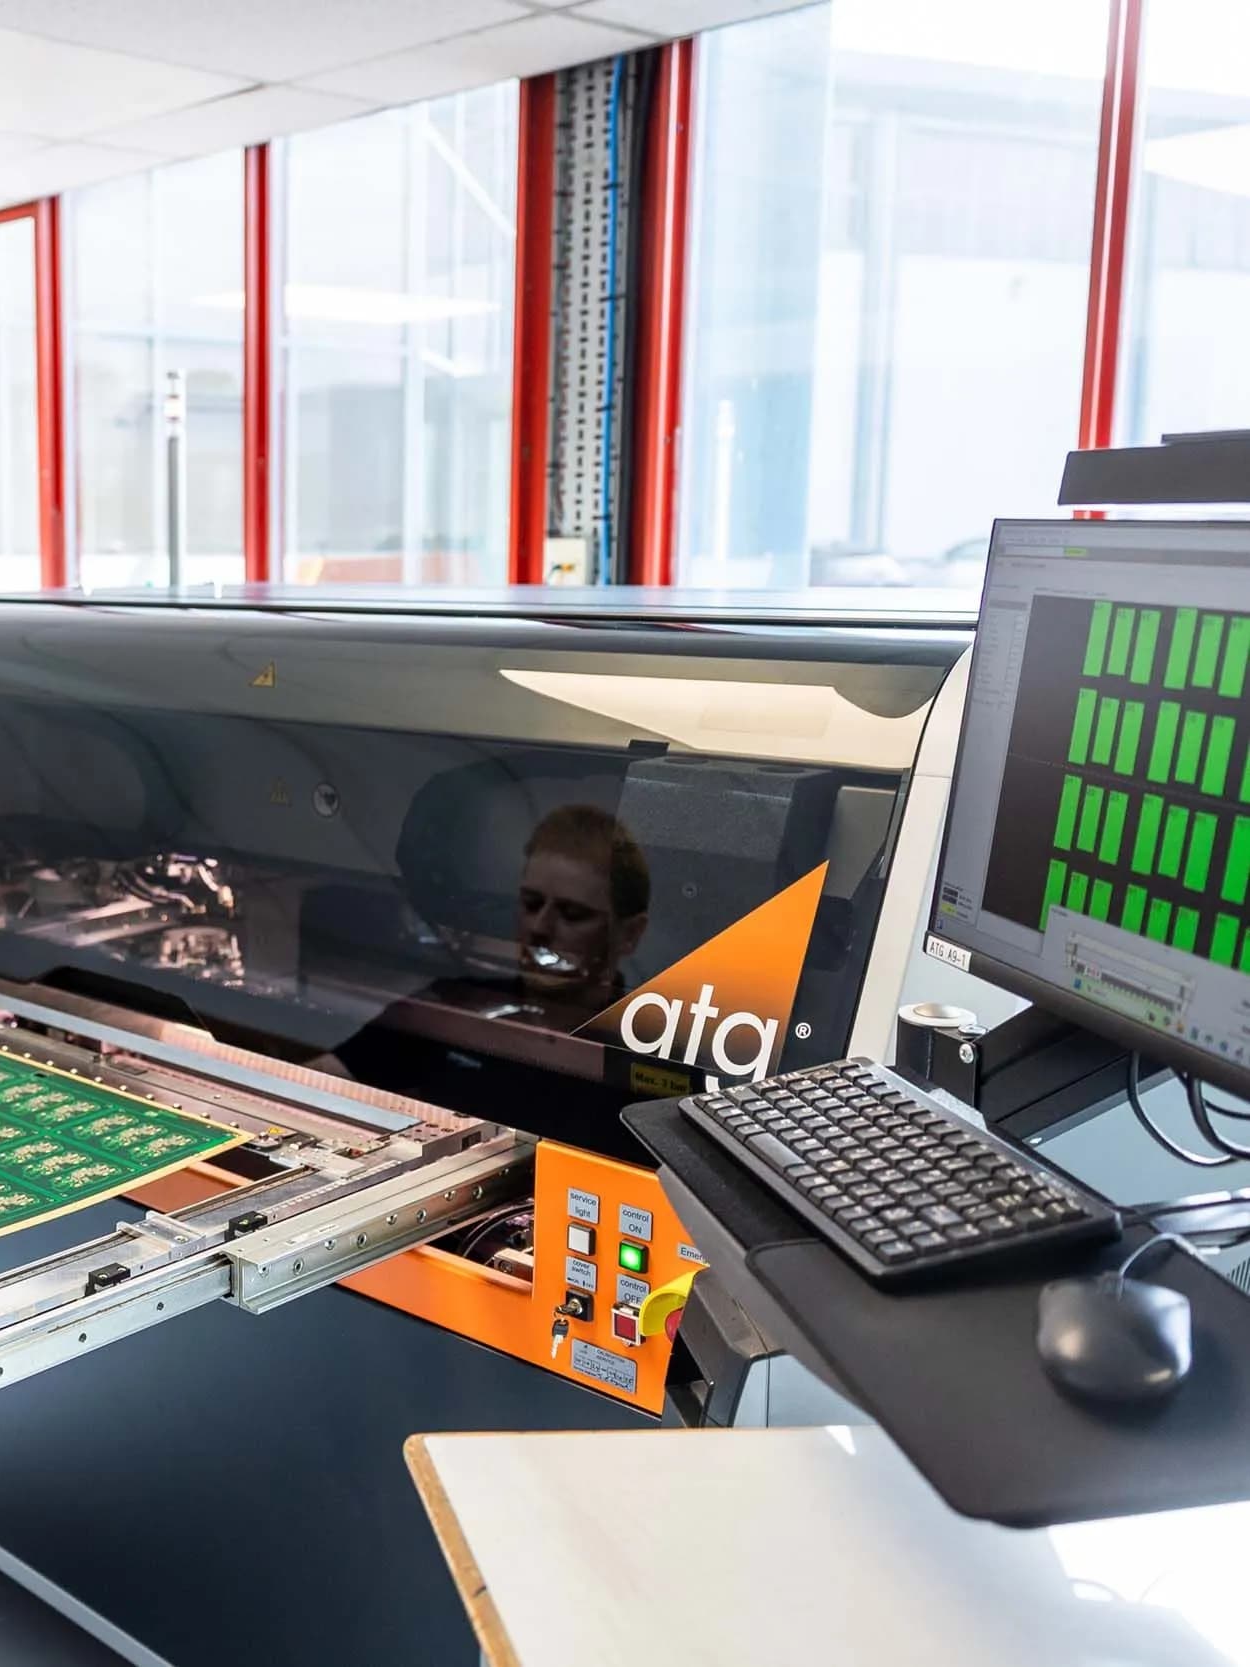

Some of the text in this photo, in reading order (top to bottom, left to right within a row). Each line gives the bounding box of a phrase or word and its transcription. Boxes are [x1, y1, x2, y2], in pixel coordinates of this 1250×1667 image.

[930, 941, 966, 967] ATG A9-1
[621, 984, 779, 1094] atg
[570, 1192, 596, 1206] service
[575, 1206, 591, 1217] light
[622, 1208, 649, 1223] control
[628, 1224, 642, 1234] ON
[573, 1260, 590, 1269] cover
[572, 1266, 591, 1277] switch
[620, 1279, 647, 1293] control
[624, 1293, 641, 1304] OFF
